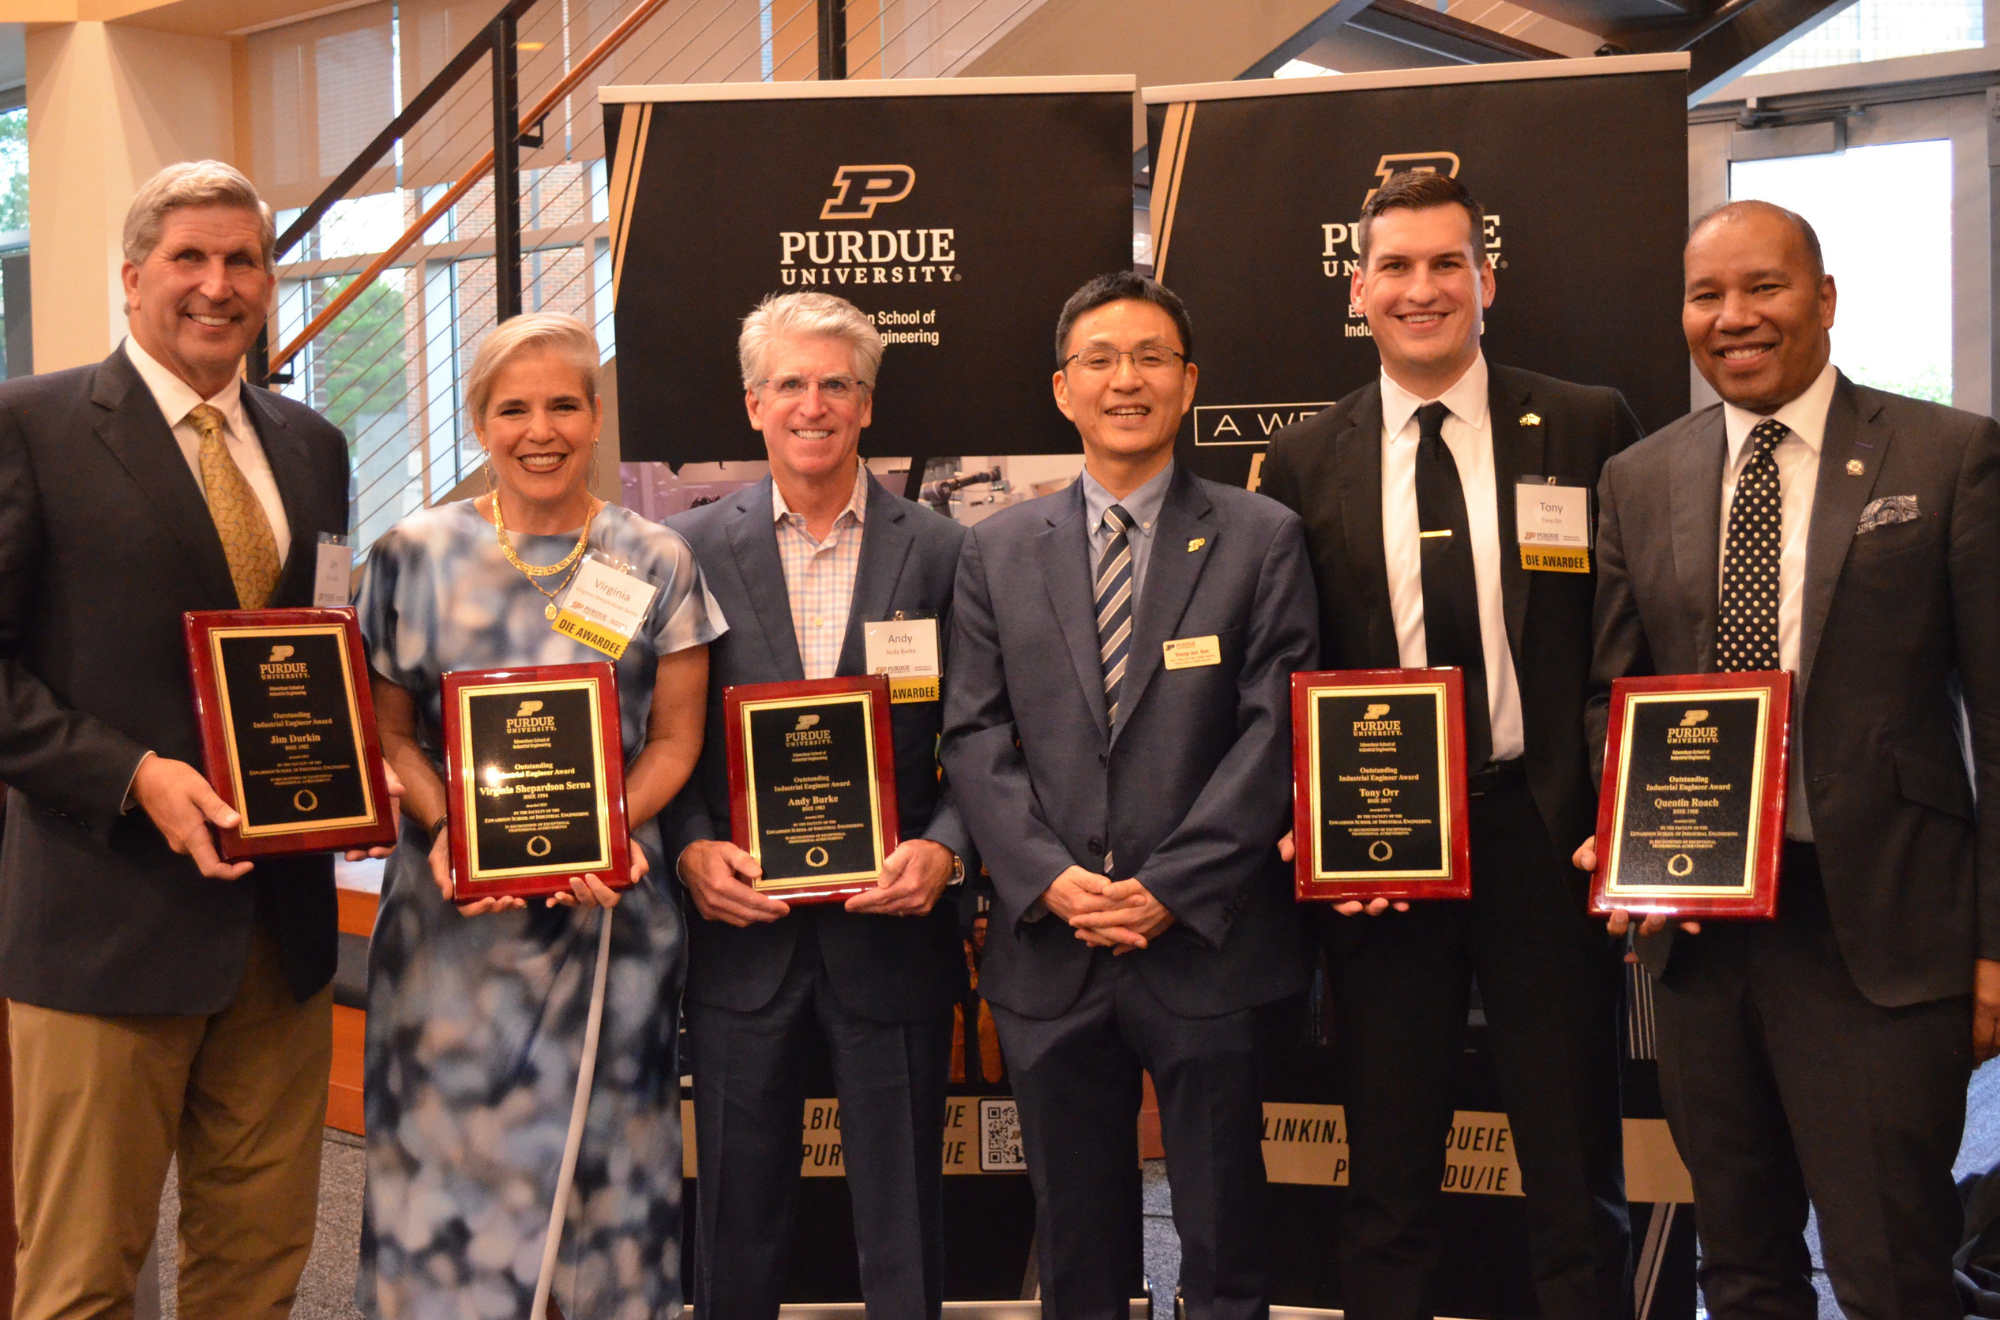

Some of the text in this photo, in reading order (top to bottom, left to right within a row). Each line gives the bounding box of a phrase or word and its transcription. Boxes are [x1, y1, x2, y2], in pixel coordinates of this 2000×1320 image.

[780, 228, 956, 264] PURDUE
[781, 266, 955, 285] UNIVERSITY
[878, 310, 920, 325] School
[922, 309, 936, 324] of
[880, 328, 940, 347] gineering
[1213, 414, 1242, 437] A
[1540, 502, 1563, 514] Tony
[1526, 554, 1584, 568] OIE AWARDEE
[595, 579, 631, 602] Virginia
[559, 619, 621, 655] OIE AWARDEE
[888, 634, 912, 644] Andy
[260, 662, 308, 674] PURDUE
[892, 687, 935, 700] AWARDEE
[285, 719, 311, 727] Engineer
[506, 716, 555, 728] PURDUE
[1353, 720, 1400, 731] PURDUE
[271, 733, 321, 744] Jim Durkin
[785, 730, 831, 742] PURDUE
[1668, 727, 1718, 738] PURDUE
[514, 762, 553, 771] Outstanding
[526, 770, 553, 778] Engineer
[479, 781, 590, 797] Virginia Shepardson Serna
[804, 782, 829, 791] Engineer
[1359, 788, 1399, 799] Tony Orr
[788, 795, 838, 807] Andy Burke
[1655, 798, 1719, 809] Quentin Roach
